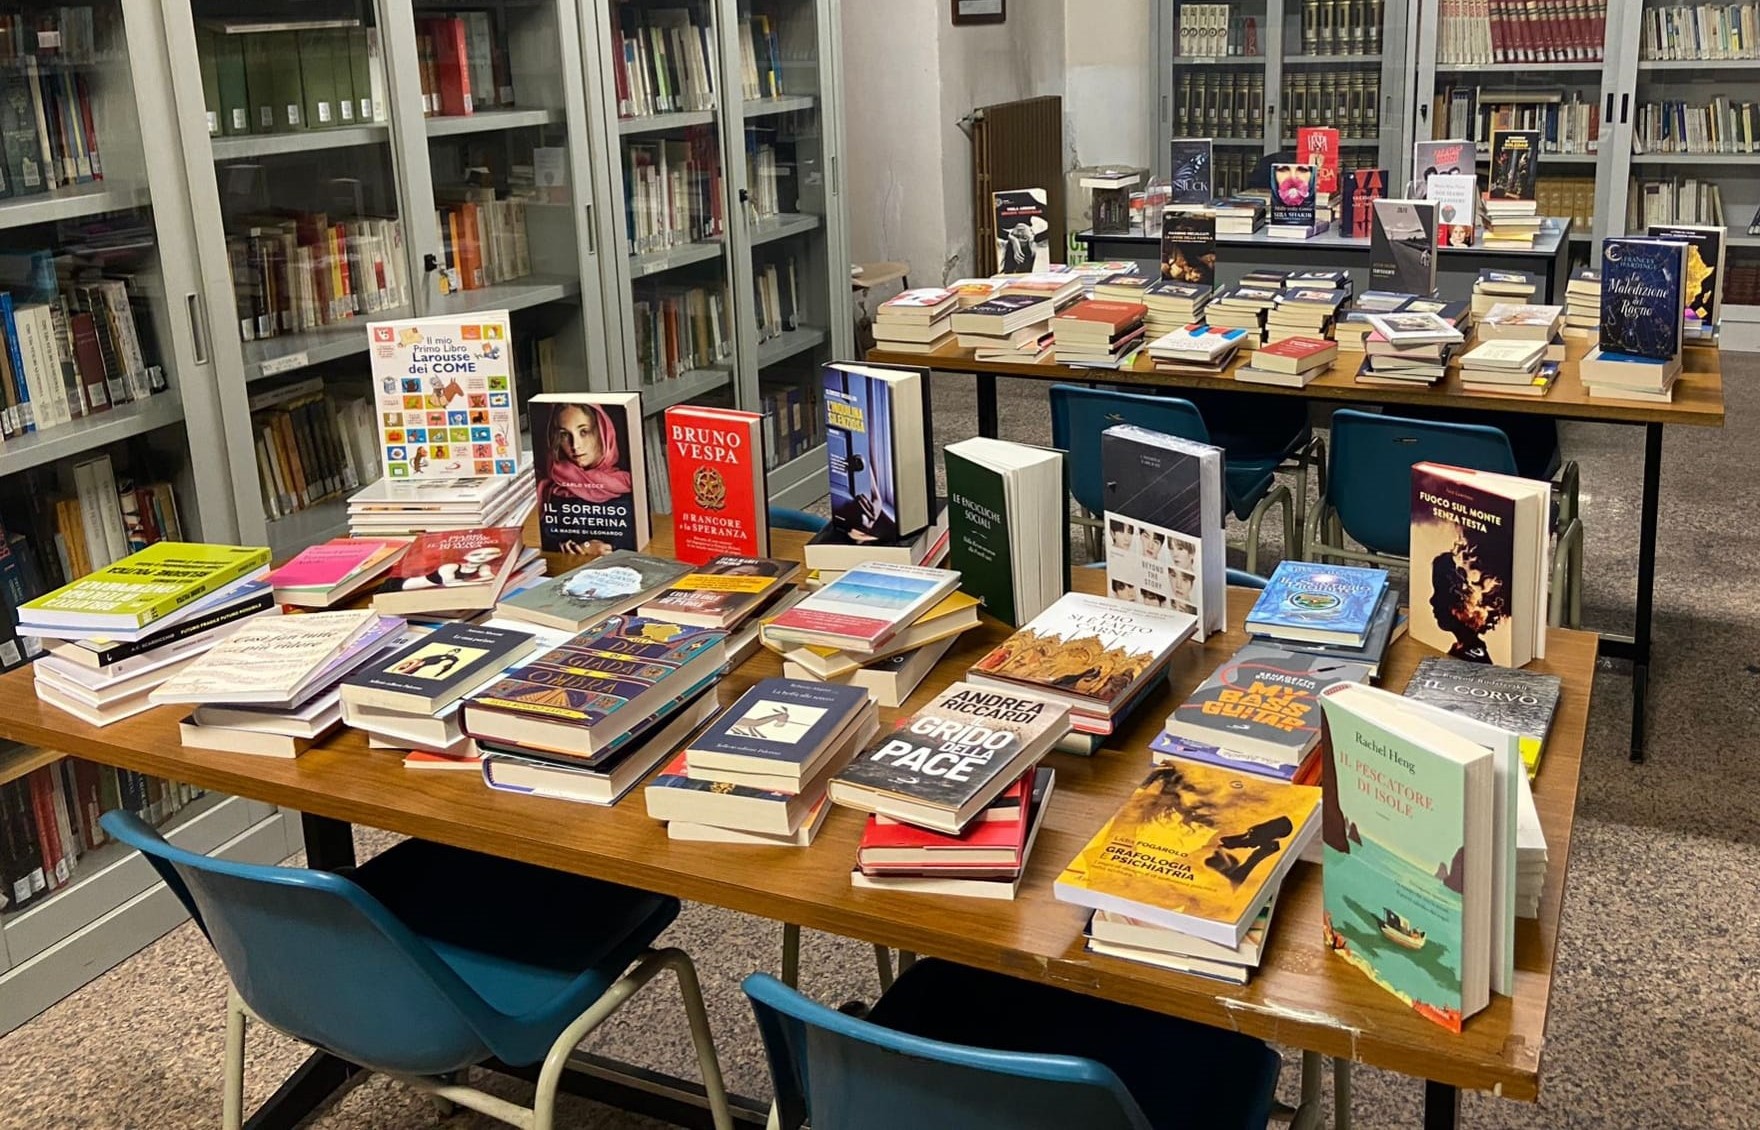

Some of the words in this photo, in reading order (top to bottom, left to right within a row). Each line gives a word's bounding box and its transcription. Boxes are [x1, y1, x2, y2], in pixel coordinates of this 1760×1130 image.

[1608, 278, 1669, 298] Maledizione
[1621, 300, 1652, 319] Ragno
[413, 352, 470, 362] Larousse
[444, 344, 467, 352] Libro
[409, 364, 428, 374] dei
[432, 362, 476, 373] COME
[672, 425, 741, 448] BRUNO
[676, 441, 739, 464] VESPA
[544, 503, 557, 512] IL
[562, 504, 627, 515] SORRISO
[953, 492, 960, 504] LE
[962, 497, 1001, 524] ENCICLICHE
[1419, 491, 1450, 508] FUOCO
[1451, 502, 1468, 514] SUL
[1469, 508, 1502, 526] MONTE
[545, 515, 558, 524] DI
[562, 516, 627, 527] CATERINA
[690, 513, 742, 529] RANCORE
[965, 509, 991, 530] SOCIALI
[1432, 507, 1460, 523] SENZA
[1461, 516, 1488, 533] TESTA
[692, 524, 747, 539] SPERANZA
[1142, 560, 1164, 574] BEYOND
[1148, 571, 1158, 580] THE
[1144, 579, 1162, 590] STORY
[1101, 613, 1133, 623] DIO
[605, 640, 648, 655] DEI
[568, 656, 637, 675] GIADA
[528, 670, 619, 694] OMBRA
[1247, 681, 1310, 697] MY
[1423, 679, 1446, 691] IL
[1454, 685, 1538, 705] CORVO
[940, 698, 1039, 725] RICCARDI
[952, 689, 1046, 715] ANDREA
[1218, 689, 1312, 718] BASS
[1202, 700, 1307, 733] GUITAR
[910, 715, 1016, 750] GRIDO
[870, 739, 989, 783] PACE
[939, 741, 996, 760] DELLA
[1355, 731, 1386, 757] Rachel
[1389, 748, 1416, 775] Heng
[1340, 751, 1351, 768] IL
[1356, 760, 1434, 812] PESCATORE
[1357, 778, 1371, 796] DI
[1375, 787, 1414, 819] ISOLE
[1105, 846, 1192, 872] GRAFOLOGIA
[1136, 841, 1189, 858] FOGAROLO
[1111, 854, 1195, 881] PSICHIATRIA
